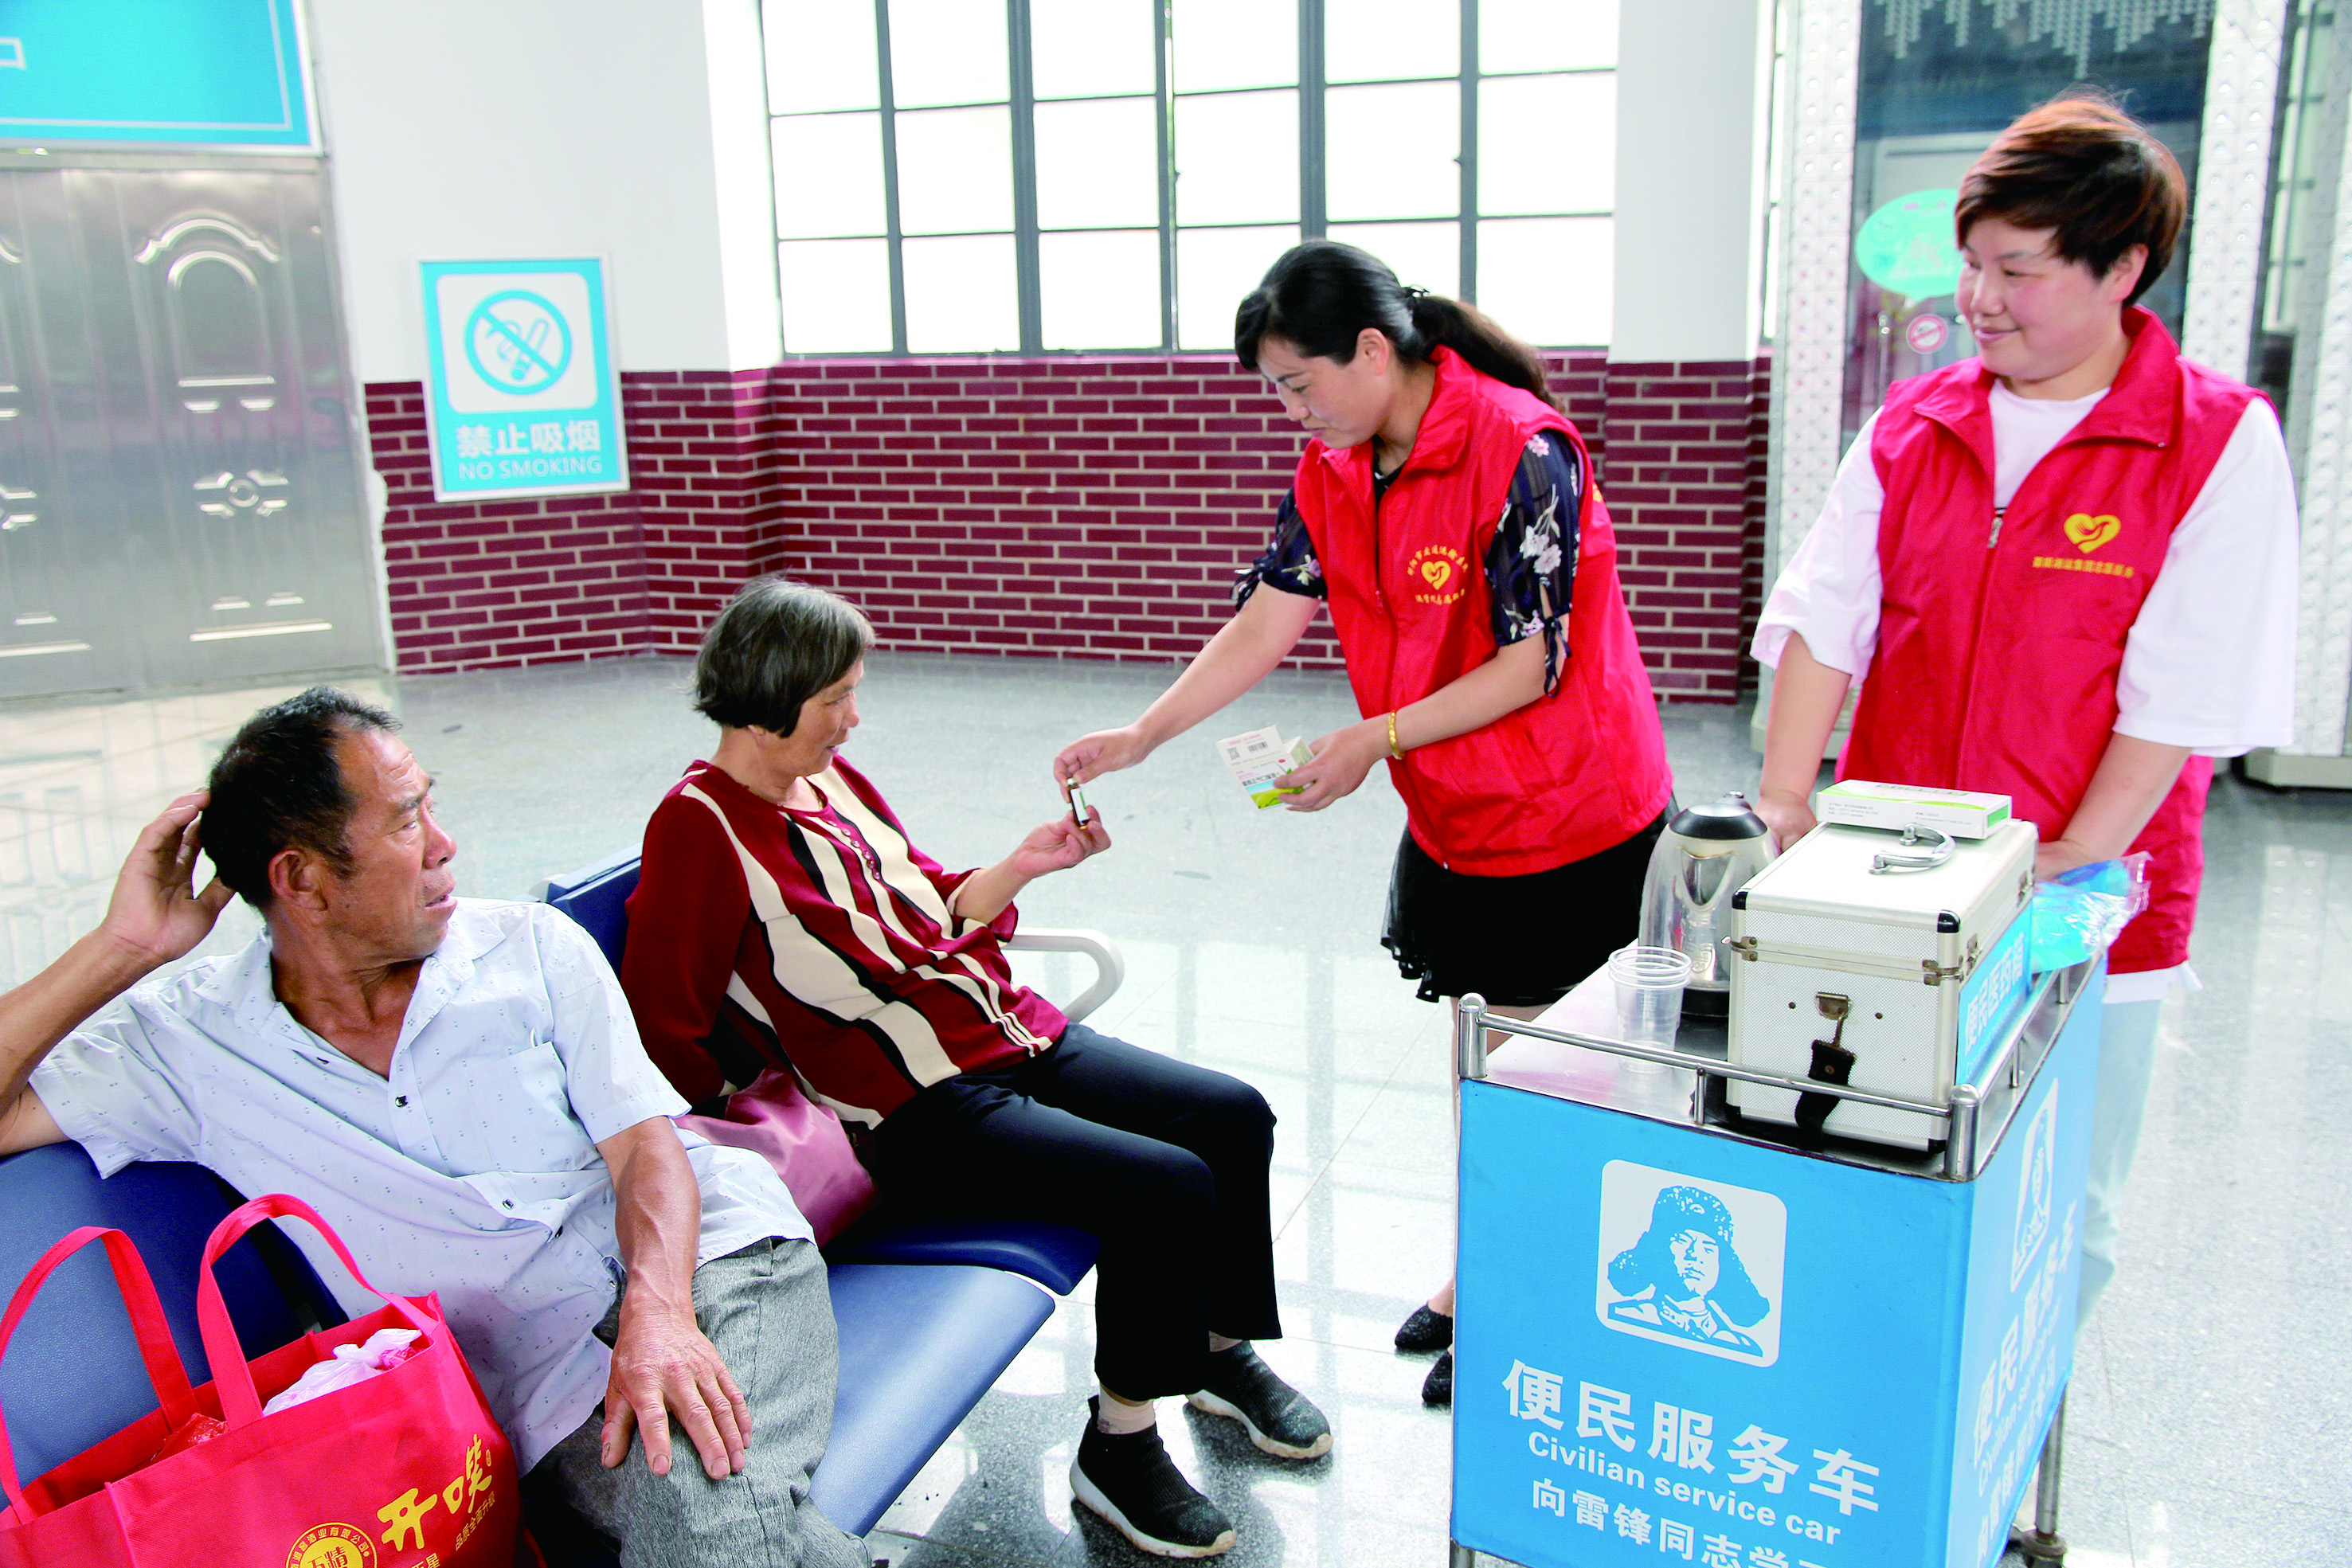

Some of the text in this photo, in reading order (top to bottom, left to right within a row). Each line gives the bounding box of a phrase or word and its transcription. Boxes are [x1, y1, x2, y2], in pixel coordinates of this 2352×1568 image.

[456, 420, 601, 458] 禁止吸烟
[458, 455, 603, 481] NO SMOKING
[1973, 1197, 2078, 1470] 便民服务车
[1501, 1359, 1880, 1516] 便民服务车
[1528, 1431, 1841, 1545] Civilian service car
[1532, 1479, 1830, 1568] 向雷锋同志学
